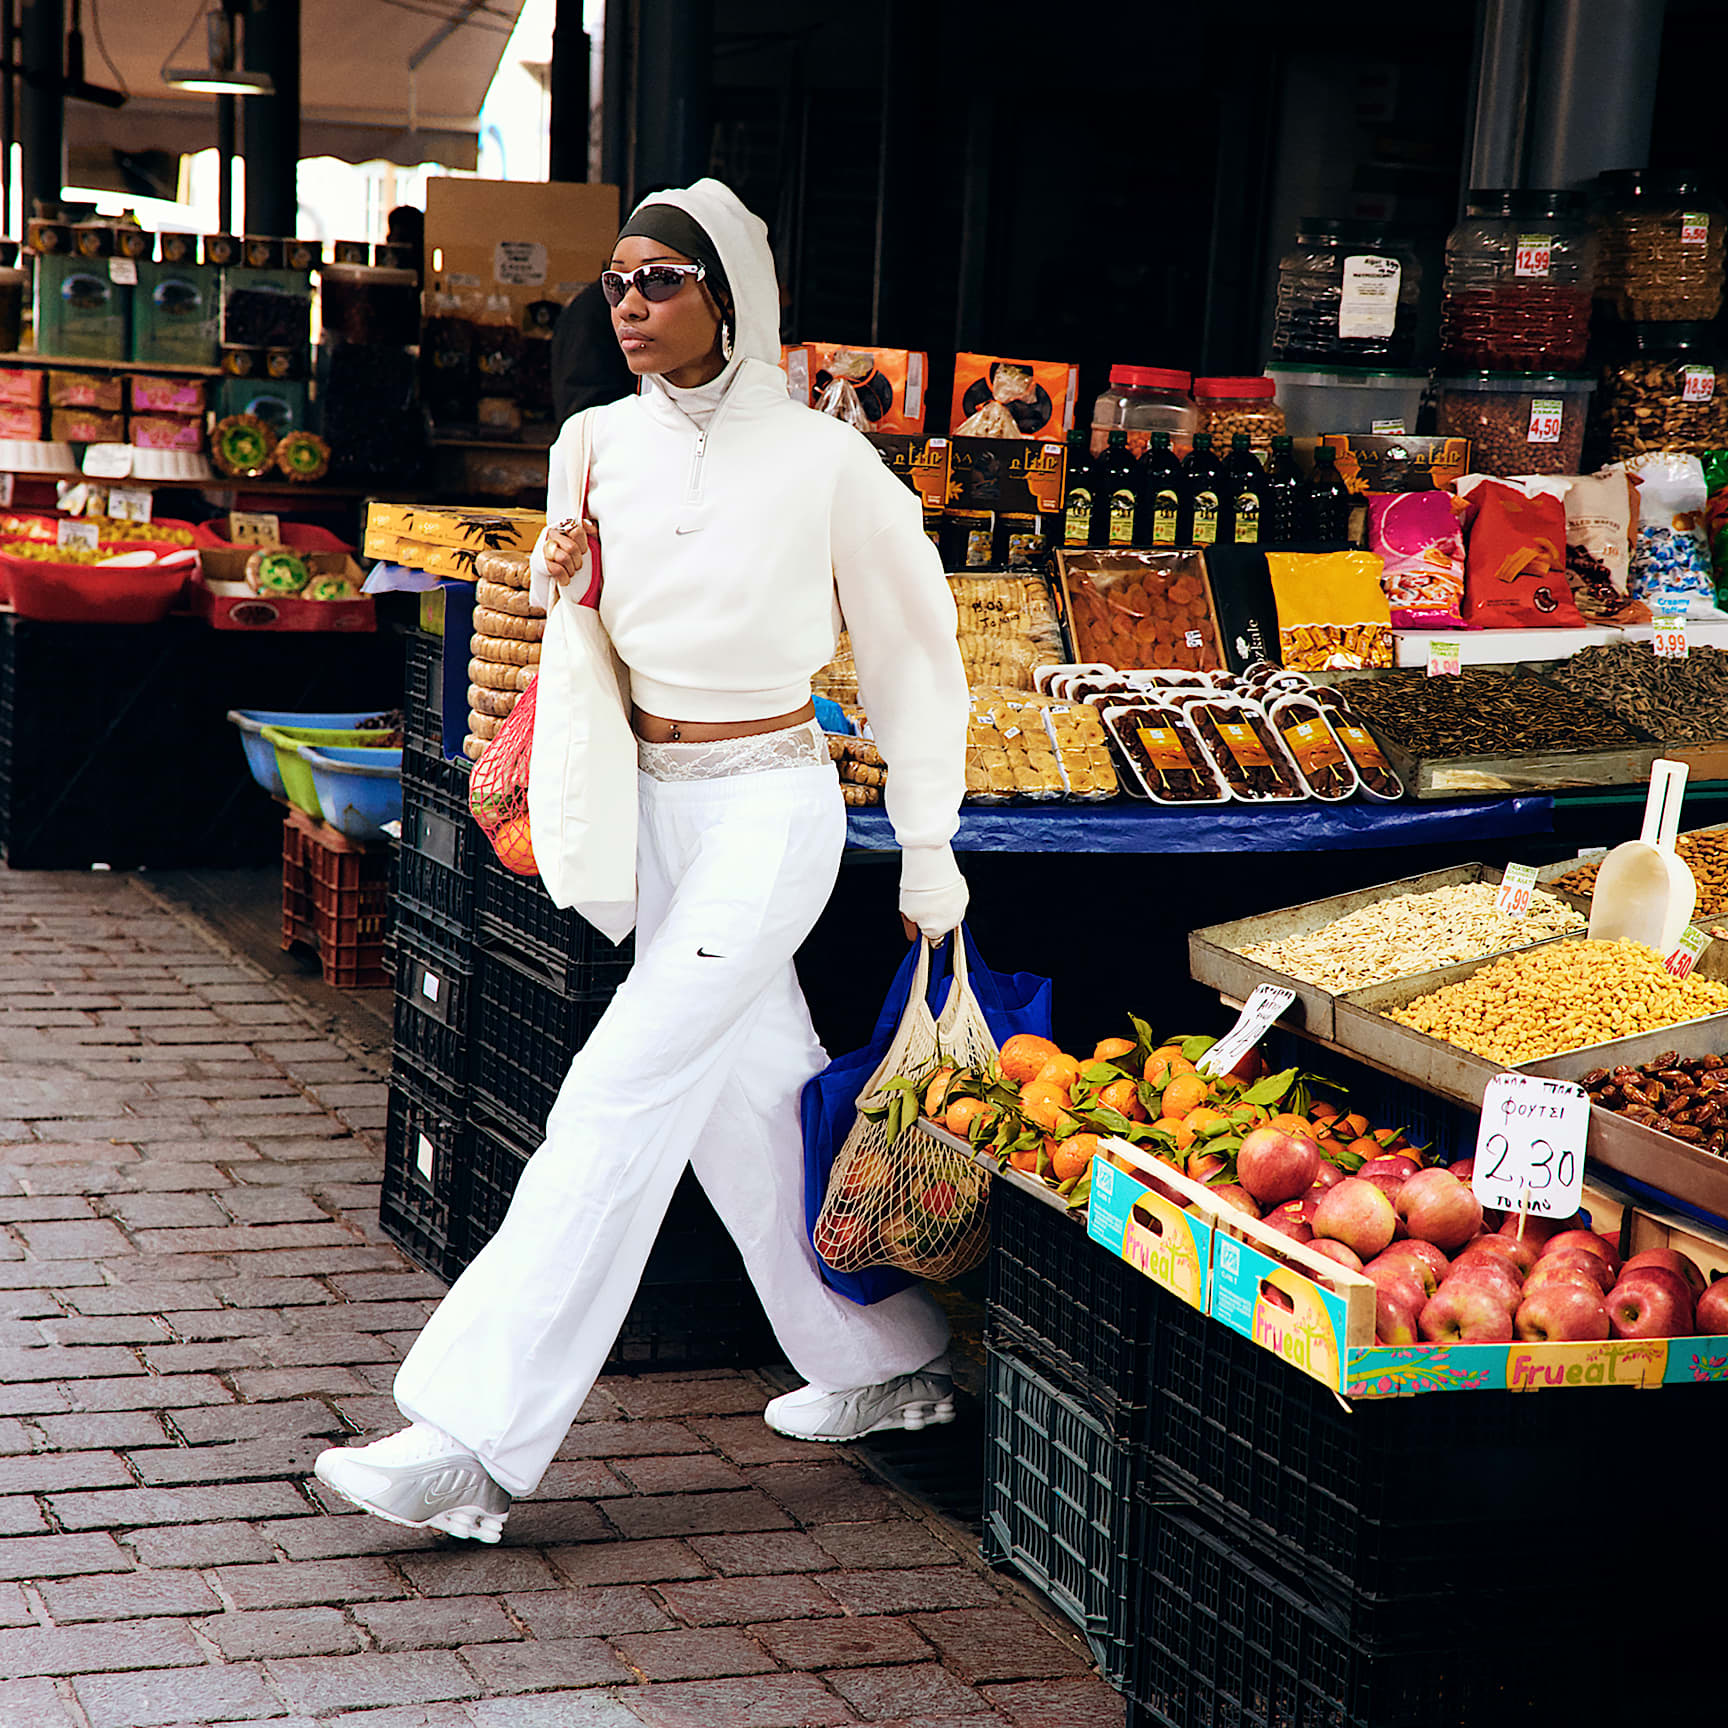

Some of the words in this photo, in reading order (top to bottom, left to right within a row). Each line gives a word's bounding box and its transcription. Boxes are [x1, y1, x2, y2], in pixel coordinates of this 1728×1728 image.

[1517, 250, 1550, 273] 12,99
[1686, 377, 1713, 397] 18,99
[1530, 417, 1560, 439] 4,50
[1655, 634, 1686, 656] 3,99
[1500, 885, 1530, 913] 7,99
[1664, 949, 1692, 980] 4,50
[1501, 1096, 1565, 1126] ΦΟΥΤΣΙ
[1485, 1133, 1575, 1189] 2,30
[1125, 1222, 1178, 1287] Frueat
[1256, 1302, 1315, 1371] Frueat
[1512, 1346, 1624, 1386] Frueat
